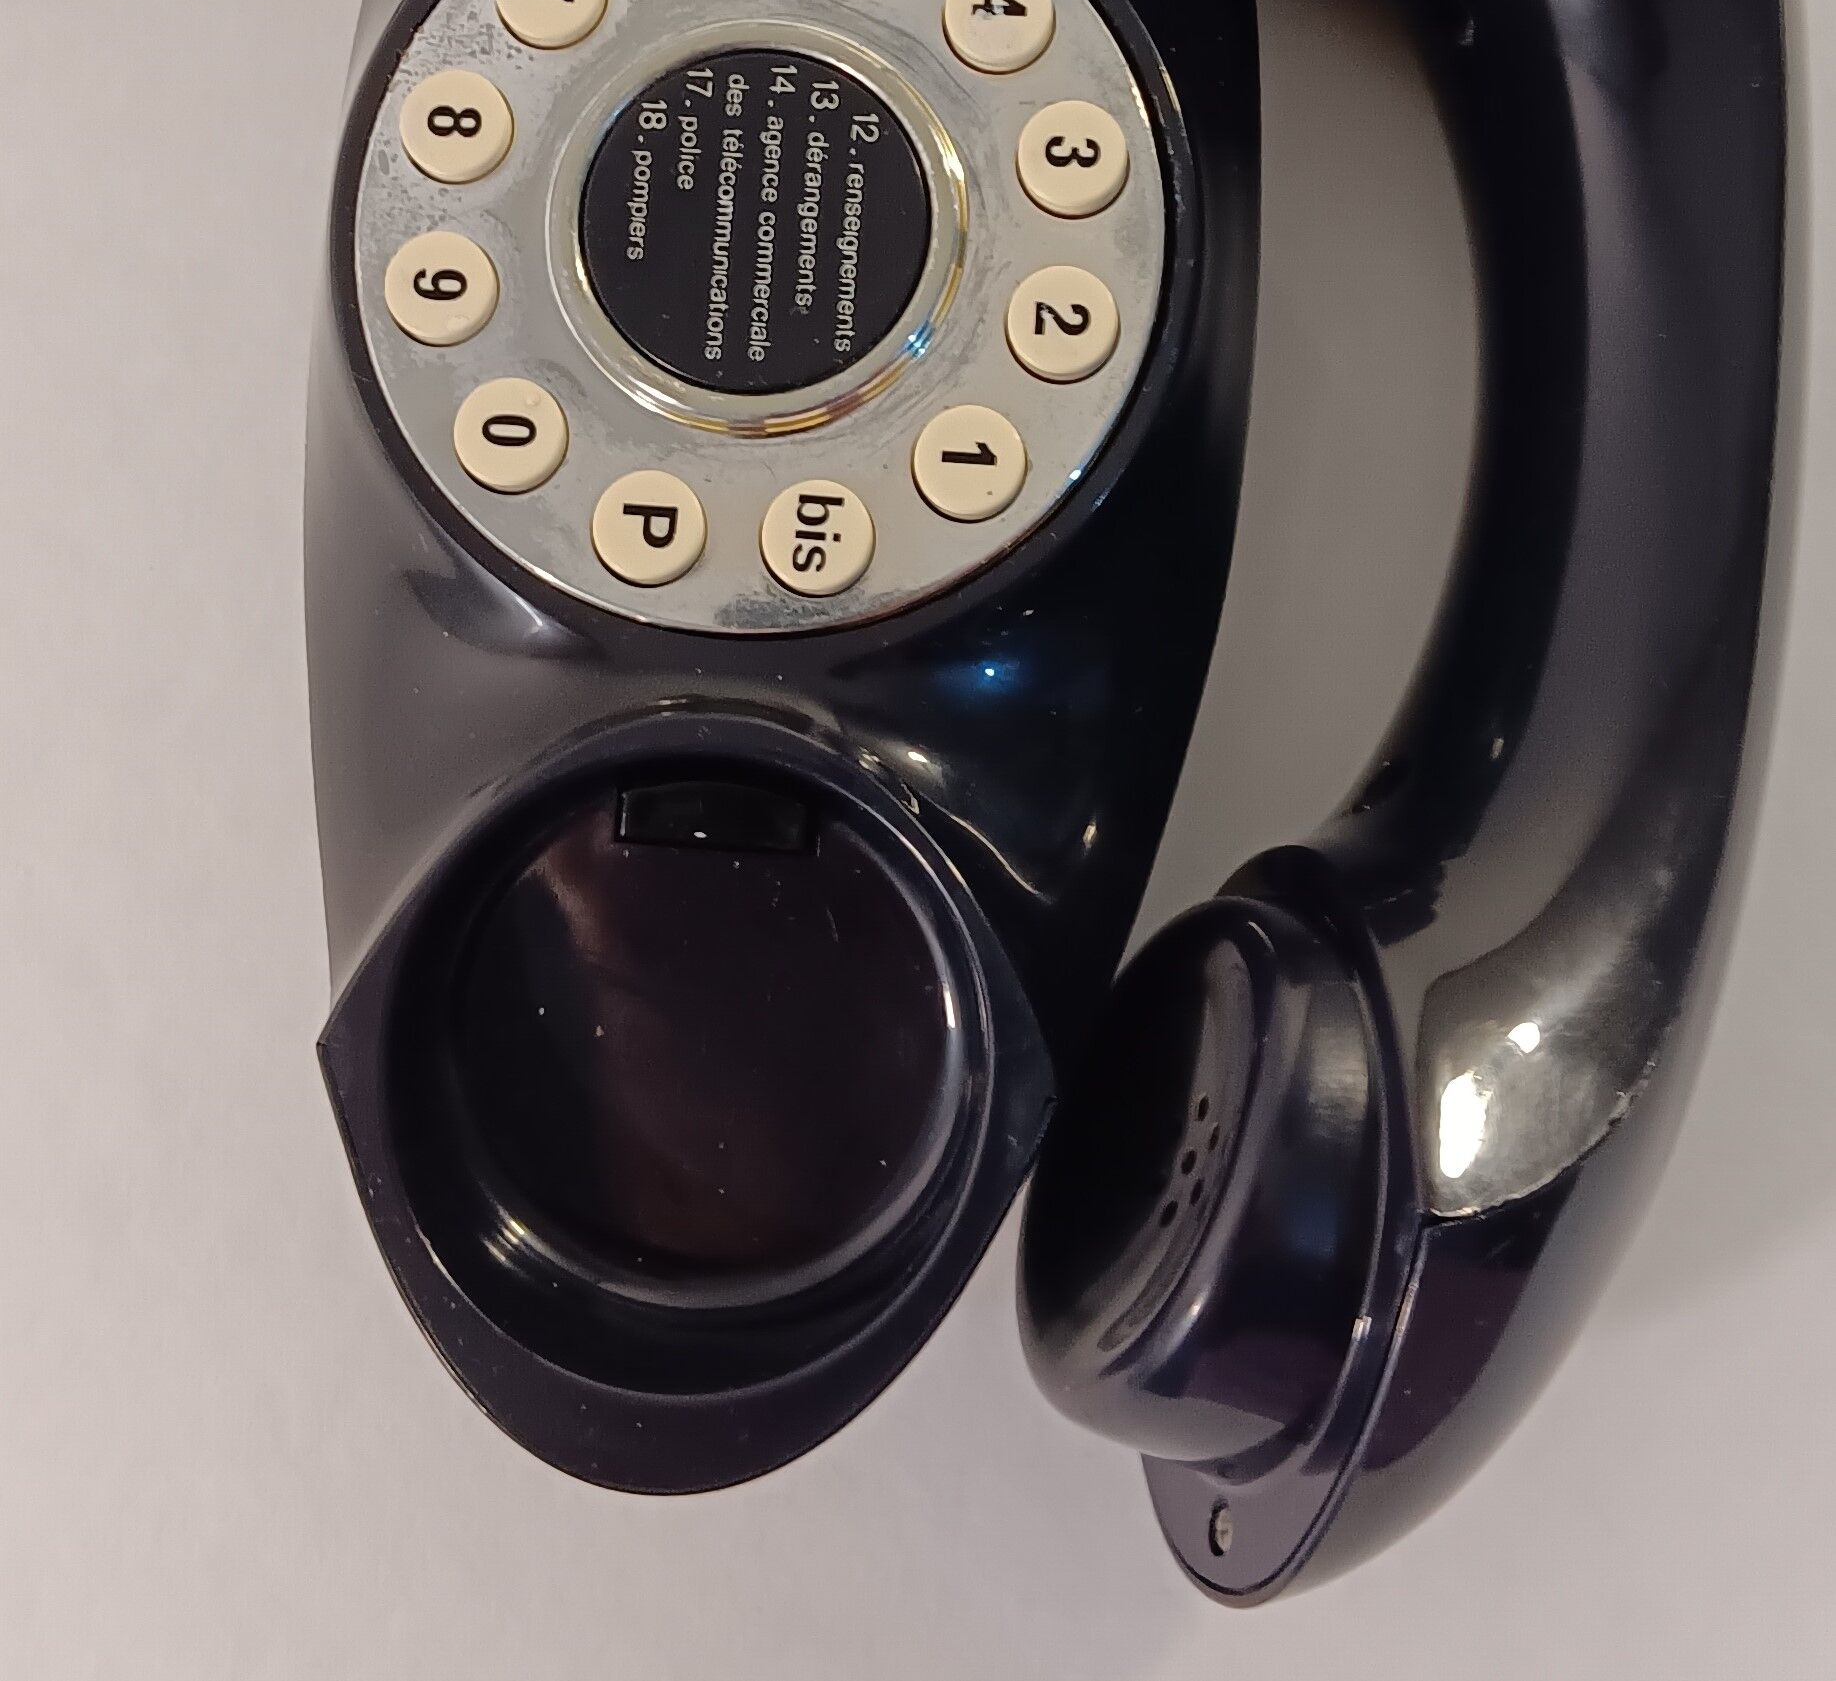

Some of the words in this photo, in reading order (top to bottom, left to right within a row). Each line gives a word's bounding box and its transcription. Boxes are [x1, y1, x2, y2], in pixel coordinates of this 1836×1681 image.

[427, 106, 482, 139] 8
[725, 74, 749, 116] des
[676, 116, 700, 190] police
[759, 116, 785, 202] agence
[1045, 136, 1101, 167] 3
[626, 150, 655, 260] pompiers
[794, 132, 829, 306] dérangements
[705, 129, 743, 360] télécommunications
[834, 162, 865, 352] renseignements
[413, 268, 468, 301] 9
[748, 212, 777, 362] commerciale
[1034, 305, 1090, 337] 2
[482, 415, 537, 446] 0
[941, 442, 997, 467] 1
[622, 503, 678, 548] P
[792, 495, 843, 572] bis
